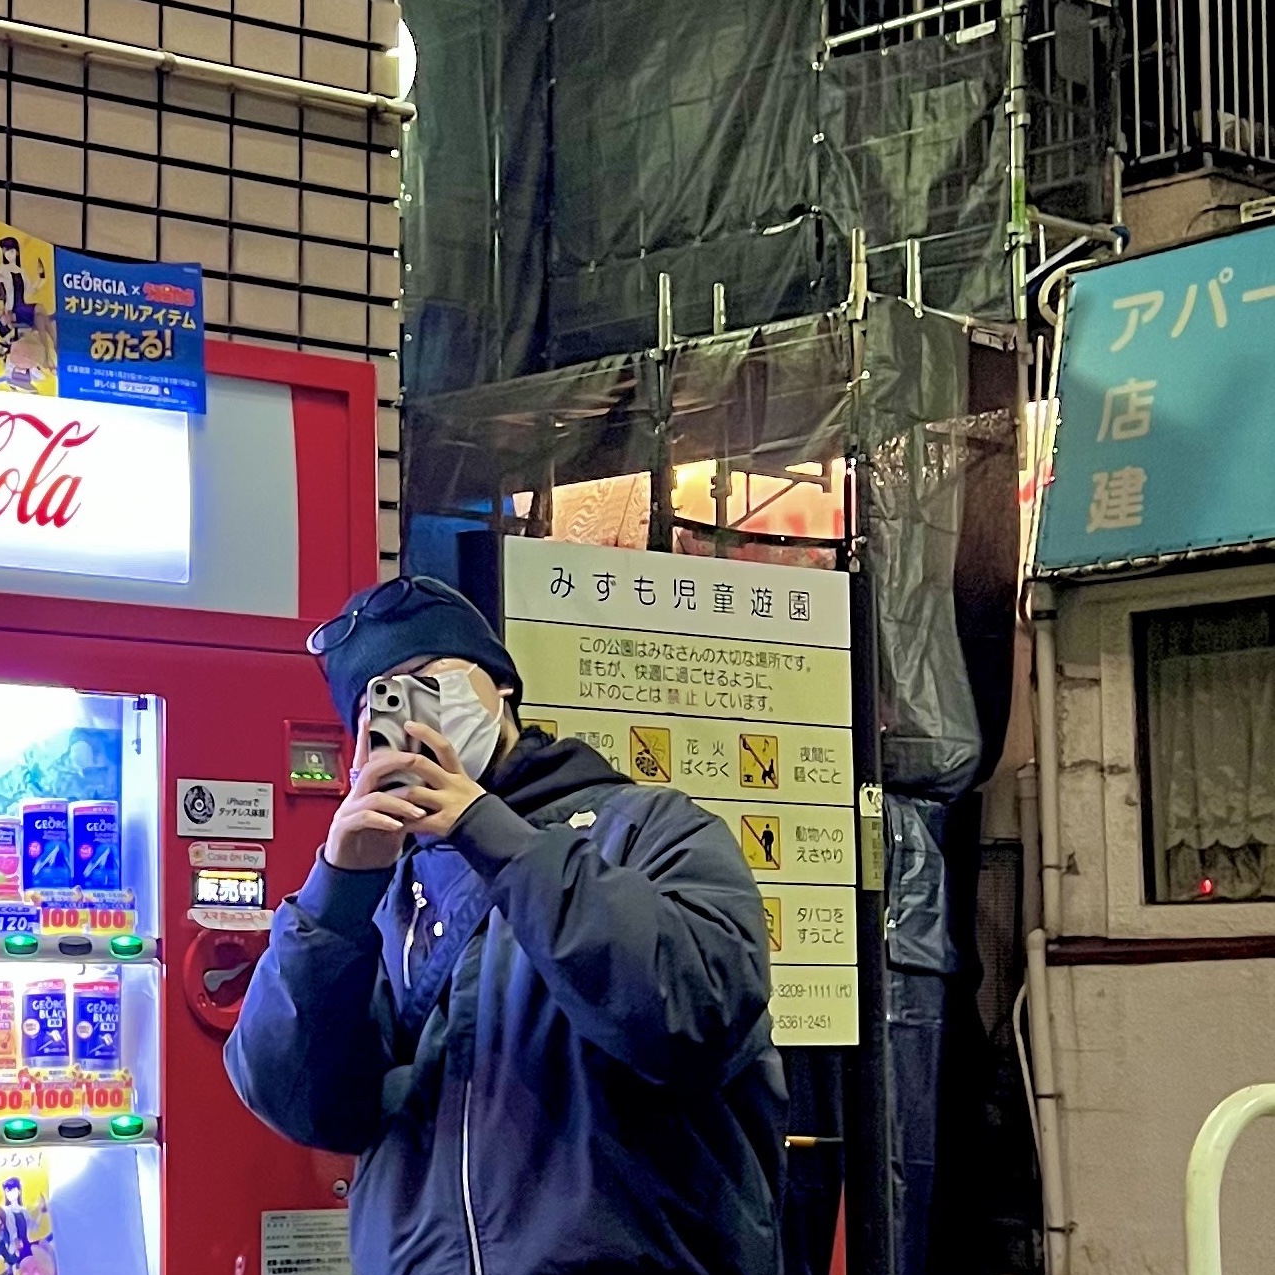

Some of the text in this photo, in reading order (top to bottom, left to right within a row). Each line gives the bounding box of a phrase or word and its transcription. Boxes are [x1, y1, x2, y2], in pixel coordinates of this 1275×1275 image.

[63, 271, 127, 296] GEORGIA
[65, 296, 196, 329] オリジナルアイテム
[91, 330, 172, 361] あたる!
[1097, 378, 1157, 442] 店
[1086, 465, 1147, 533] 建
[550, 567, 811, 621] みずも児童遊園
[580, 636, 812, 673] この公園はみなさんの大切な場所です。
[680, 760, 730, 777] ばくちく
[795, 826, 844, 843] 動物への
[796, 847, 843, 864] えさやり
[797, 908, 844, 923] タバコを
[797, 928, 844, 944] すうこと
